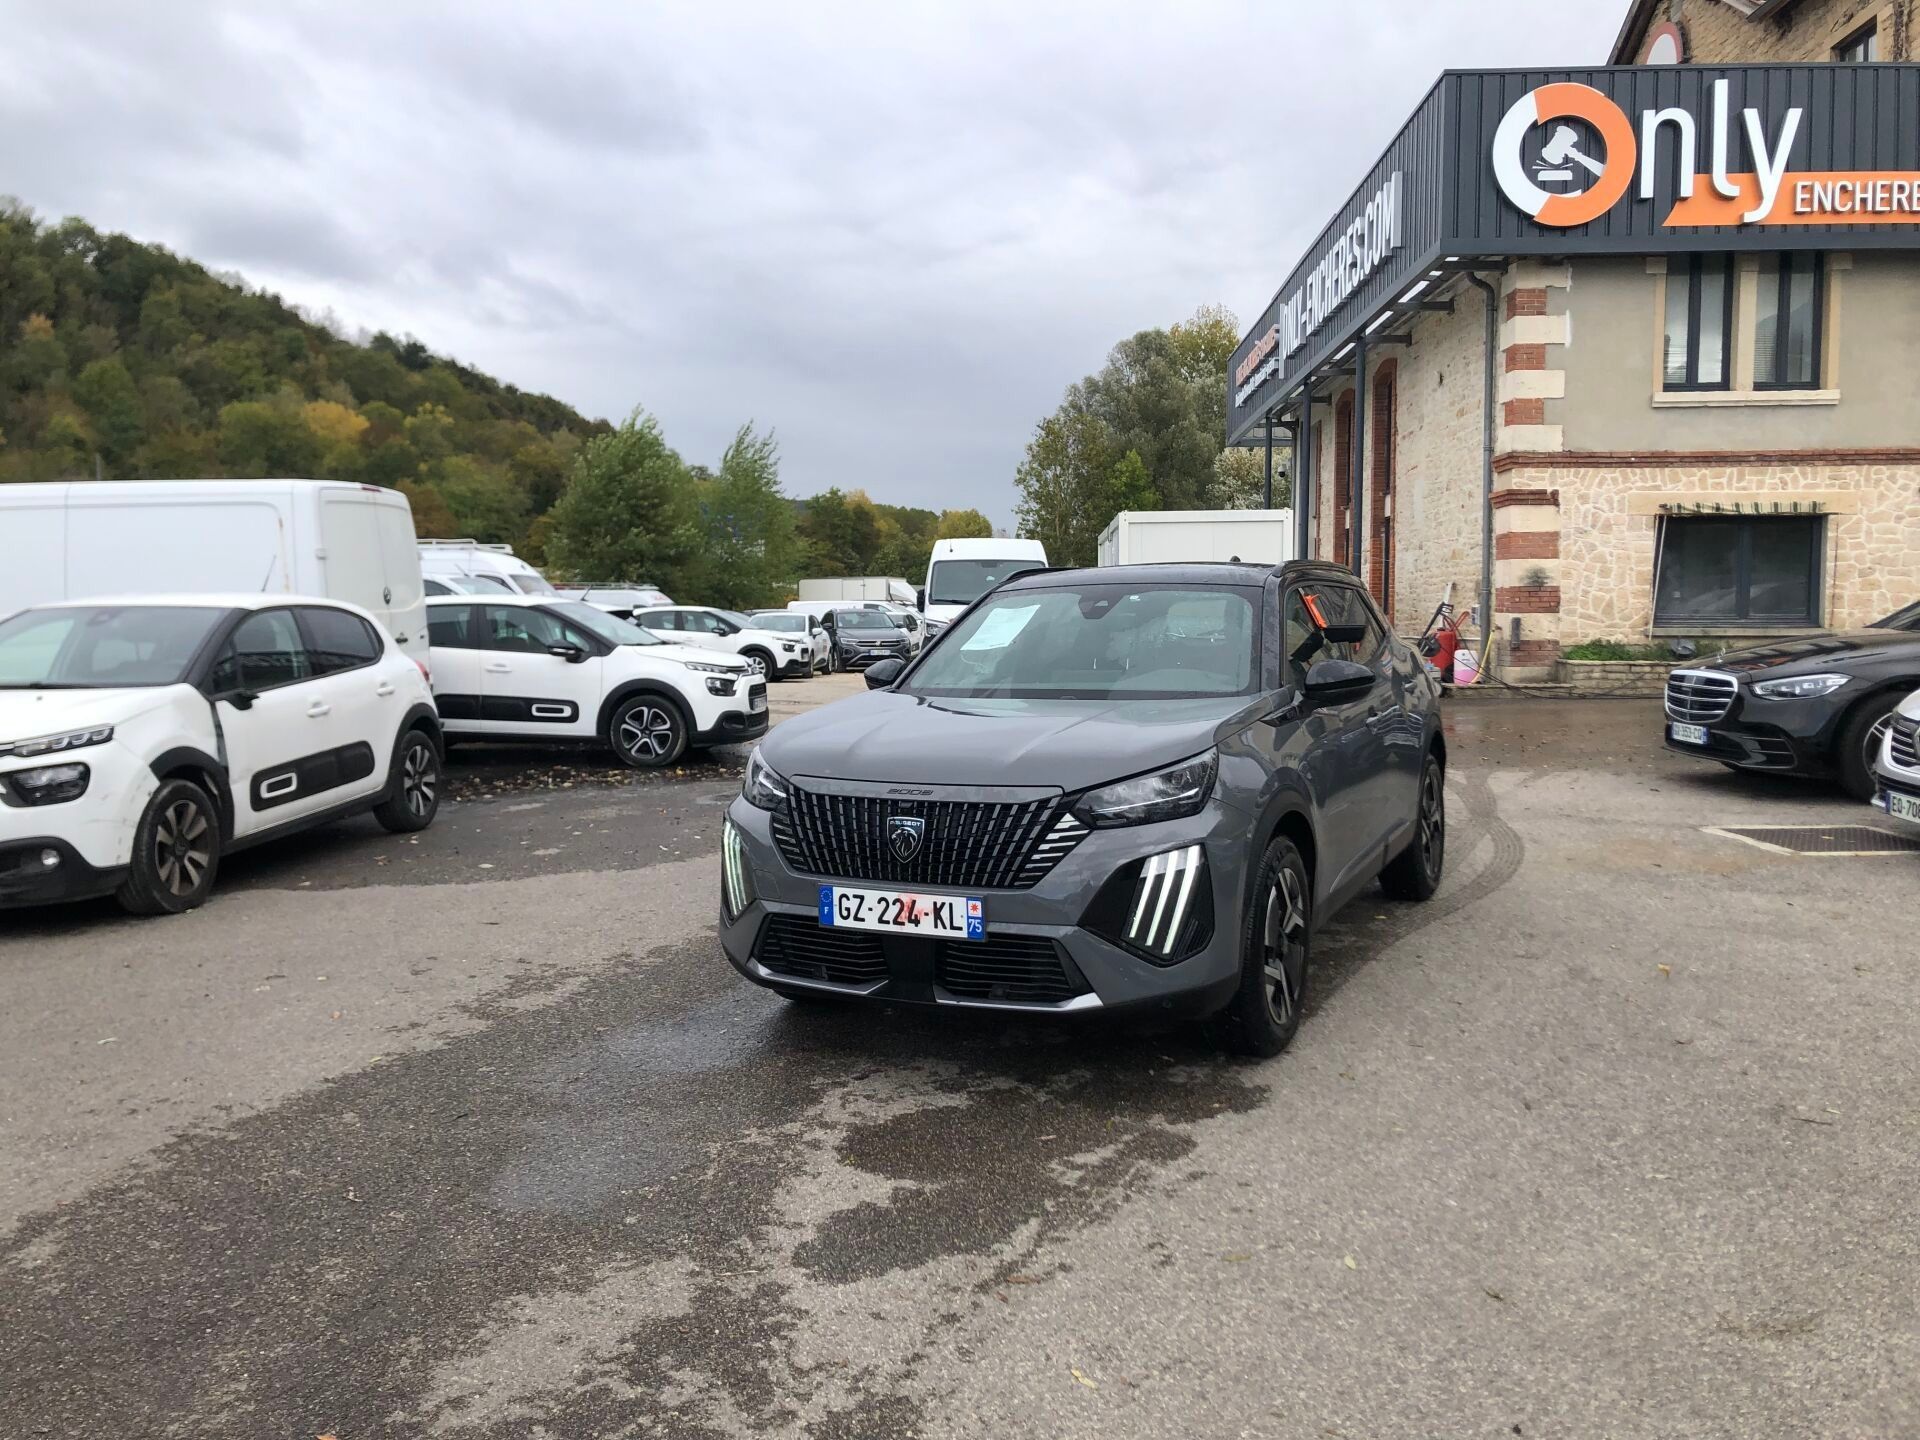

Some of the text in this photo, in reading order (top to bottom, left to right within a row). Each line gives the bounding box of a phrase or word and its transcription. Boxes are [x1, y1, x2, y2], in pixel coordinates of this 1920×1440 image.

[1493, 78, 1803, 227] Only
[887, 788, 934, 796] 2008
[838, 893, 963, 931] GZ-224-KL
[968, 918, 982, 933] 75
